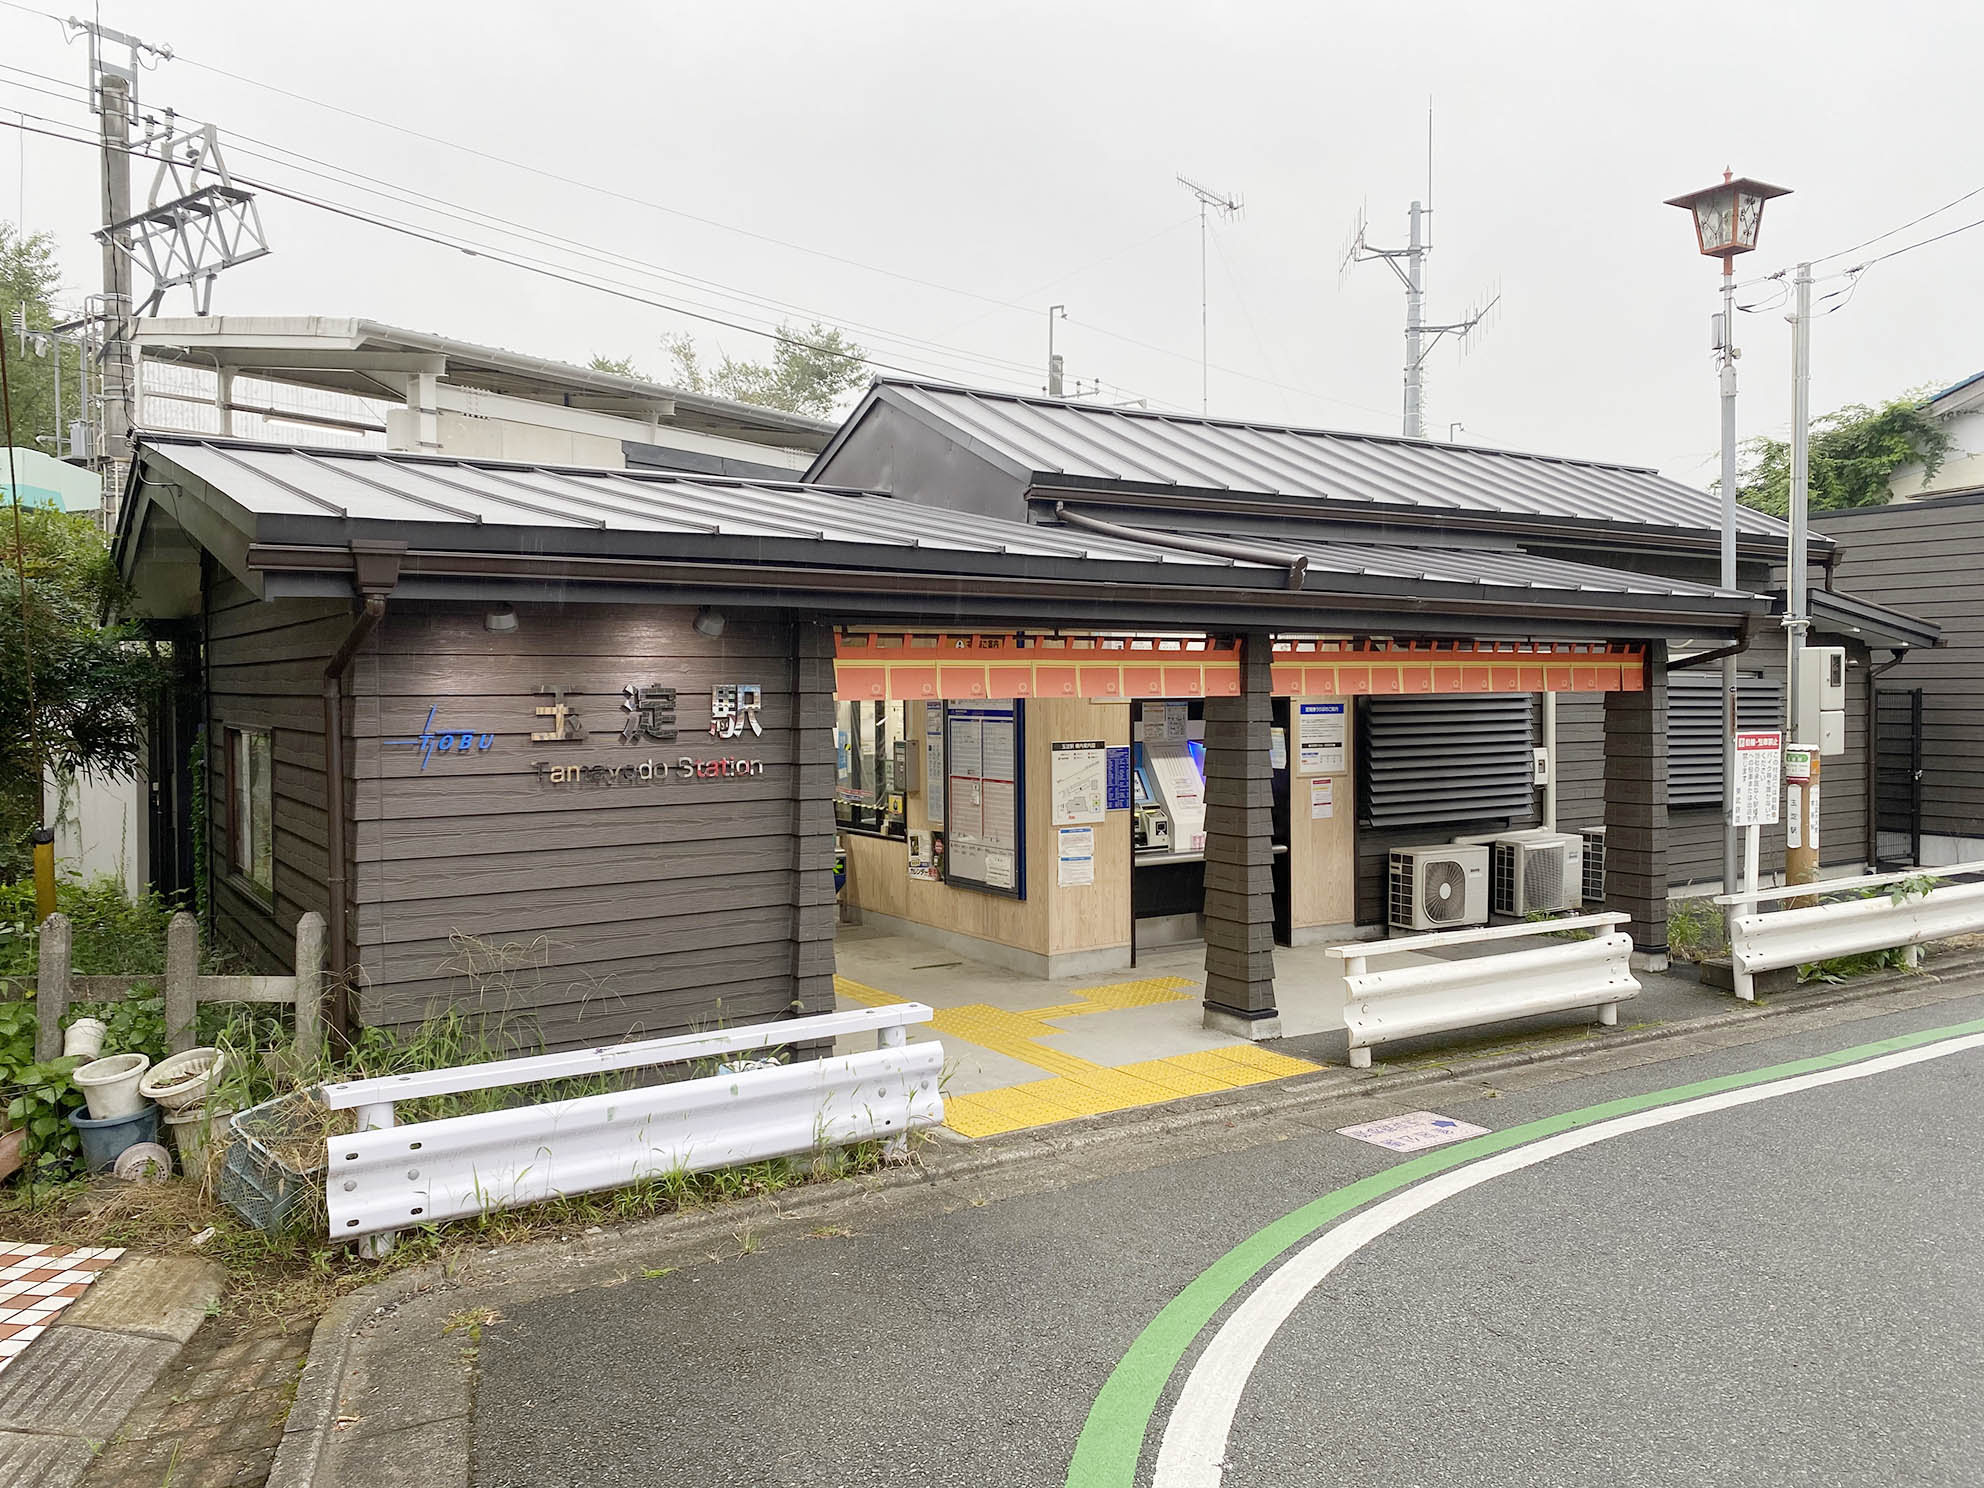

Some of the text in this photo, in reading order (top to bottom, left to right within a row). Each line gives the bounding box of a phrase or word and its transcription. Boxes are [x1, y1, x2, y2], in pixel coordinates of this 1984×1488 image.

[531, 683, 763, 743] 玉淀駅
[532, 756, 763, 786] Tamayodo Station
